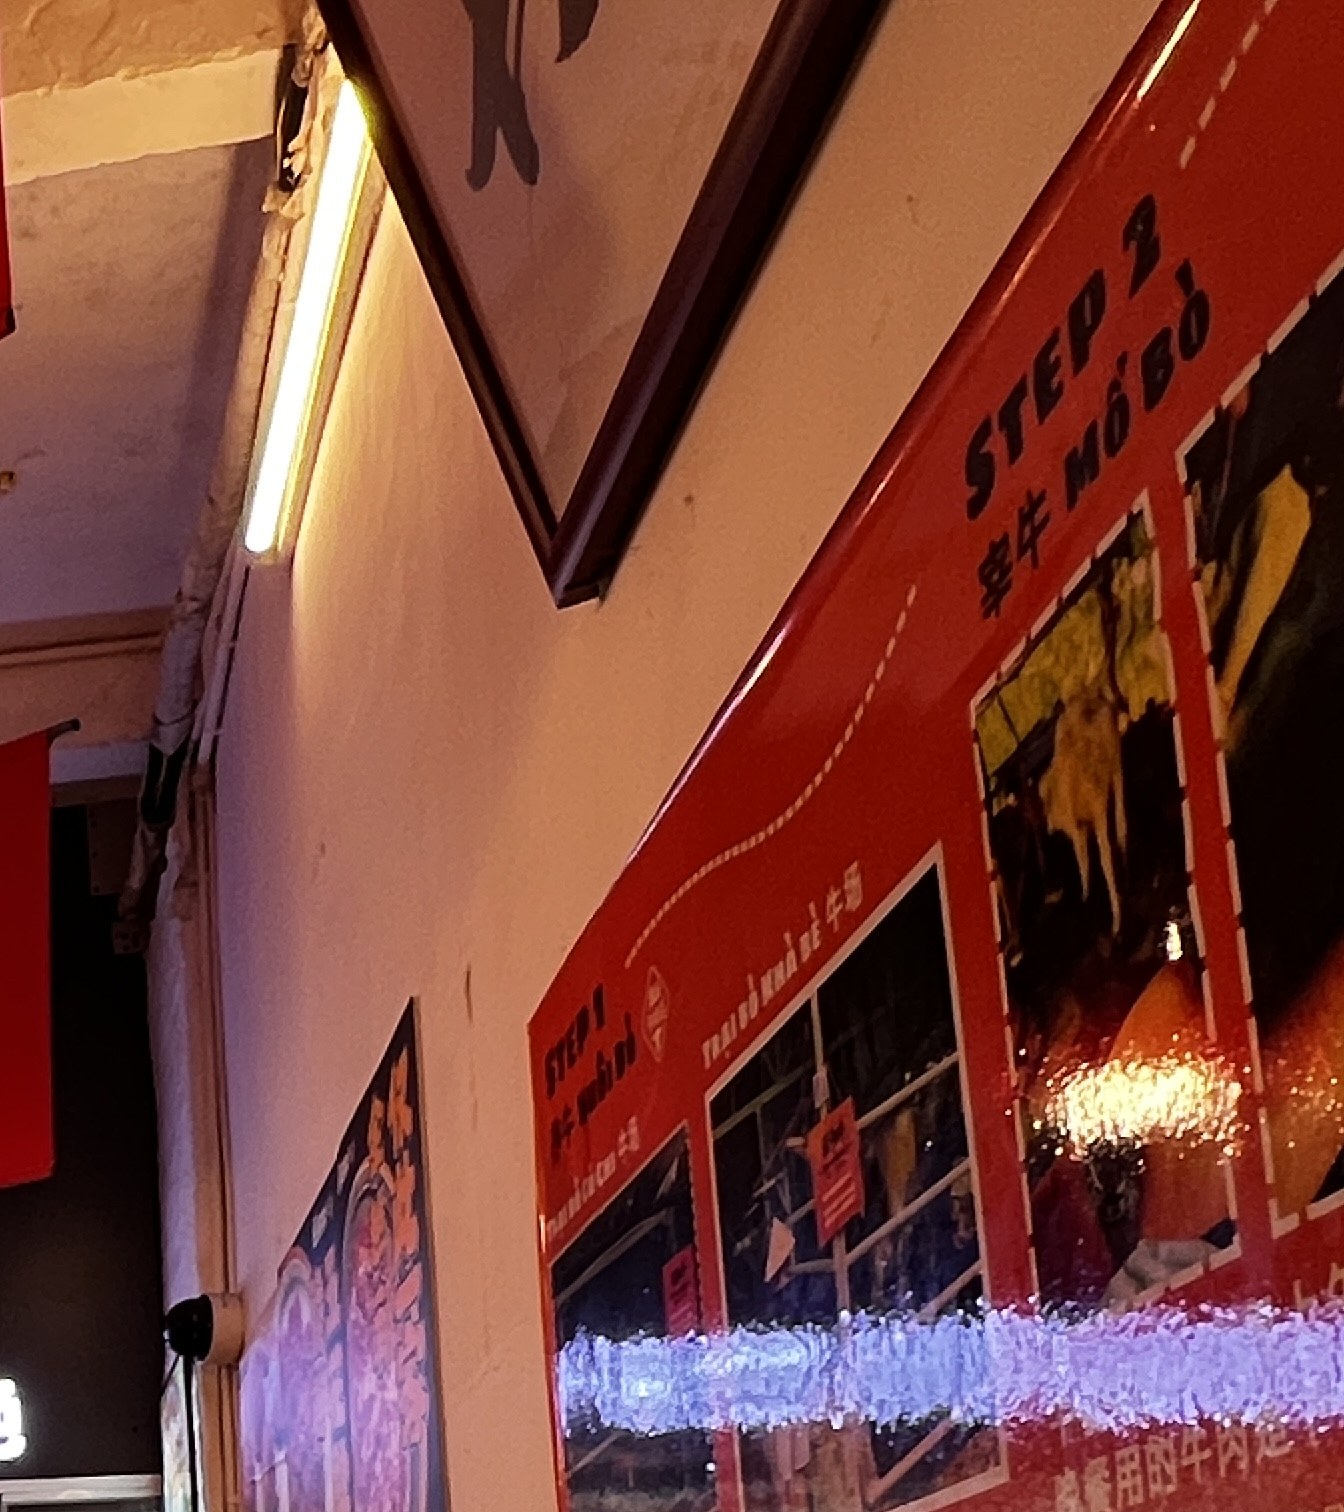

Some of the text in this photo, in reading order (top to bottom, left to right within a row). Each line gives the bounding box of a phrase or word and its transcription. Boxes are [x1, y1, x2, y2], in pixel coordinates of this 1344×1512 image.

[965, 194, 1161, 521] STEP 2
[1140, 258, 1210, 411] BÒ
